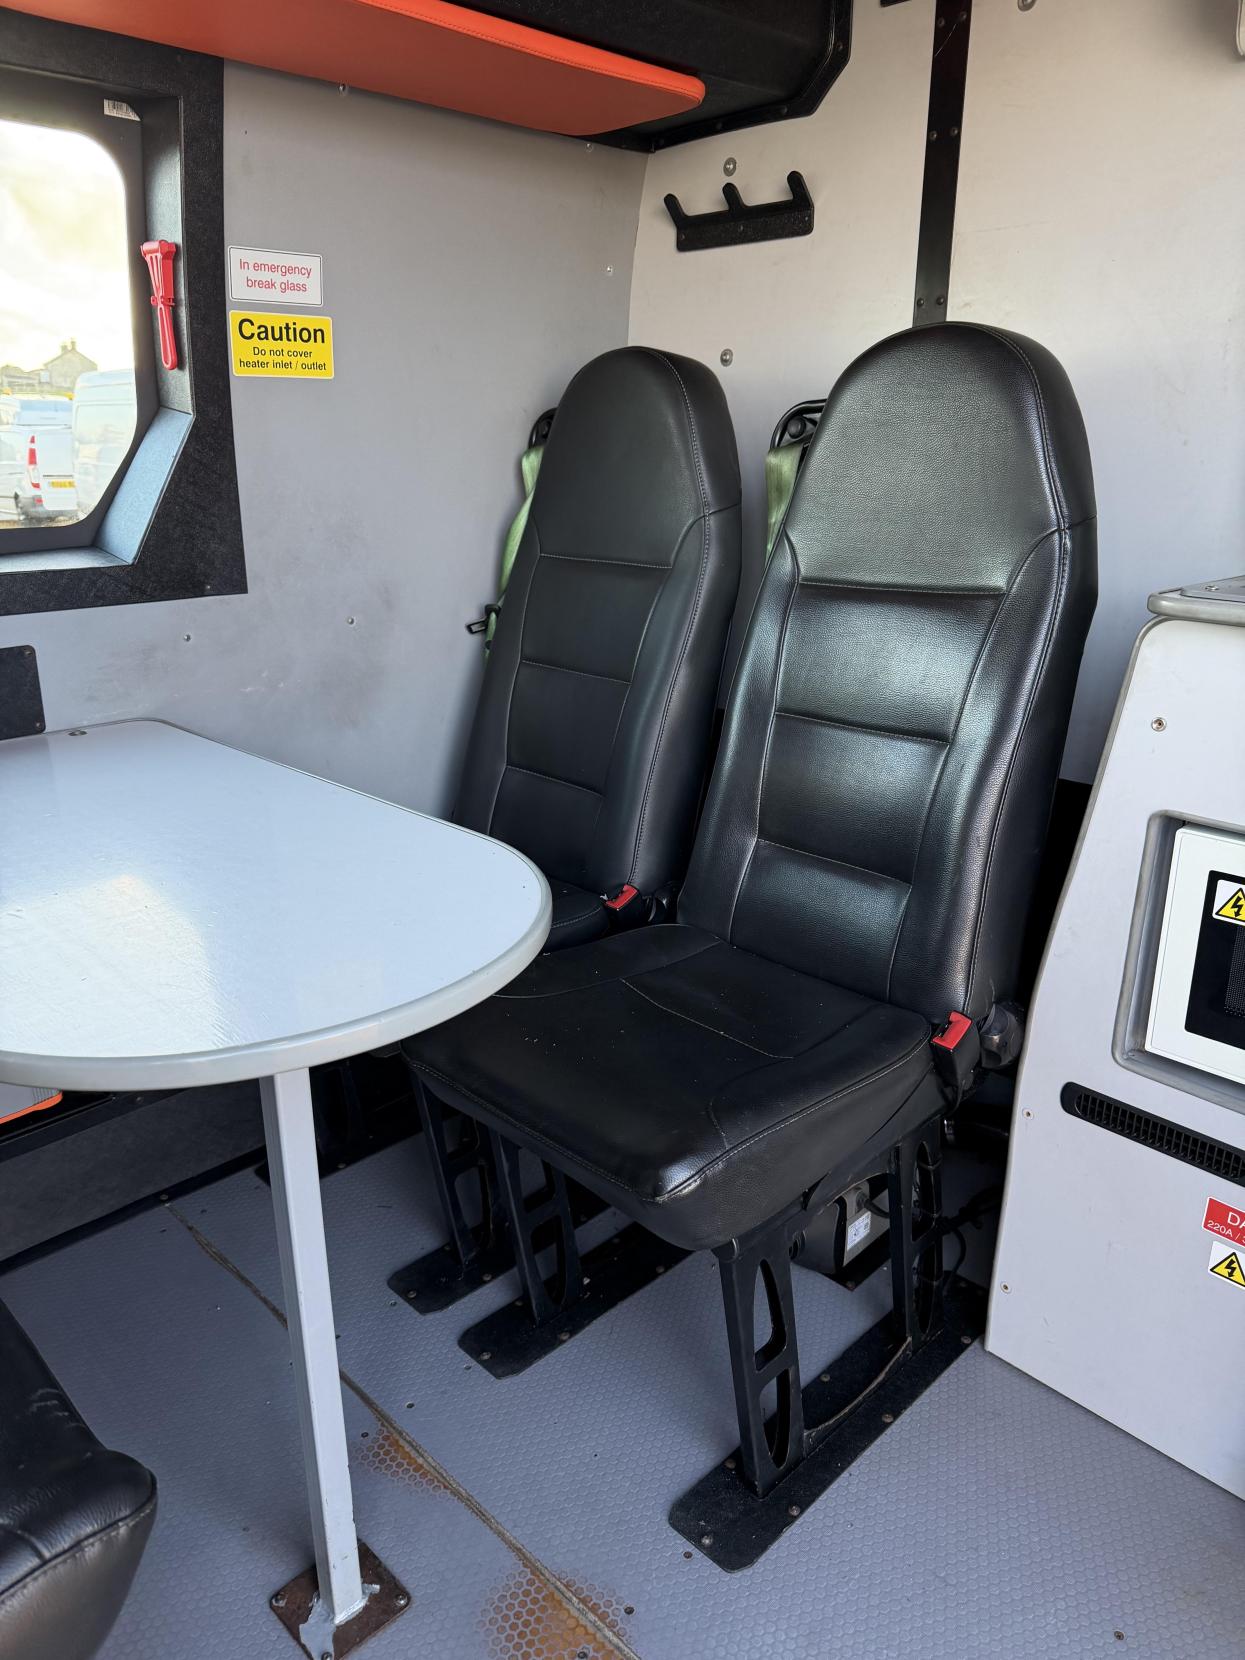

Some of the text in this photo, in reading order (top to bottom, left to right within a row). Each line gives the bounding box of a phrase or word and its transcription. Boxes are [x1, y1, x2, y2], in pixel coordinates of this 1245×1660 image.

[239, 258, 312, 278] In emergency
[246, 276, 307, 293] break glass
[238, 318, 325, 344] Caution
[253, 347, 312, 358] Do not cover
[239, 358, 269, 369] heater
[272, 359, 293, 370] inlet
[301, 362, 326, 371] outlet
[1207, 1220, 1233, 1238] 220A
